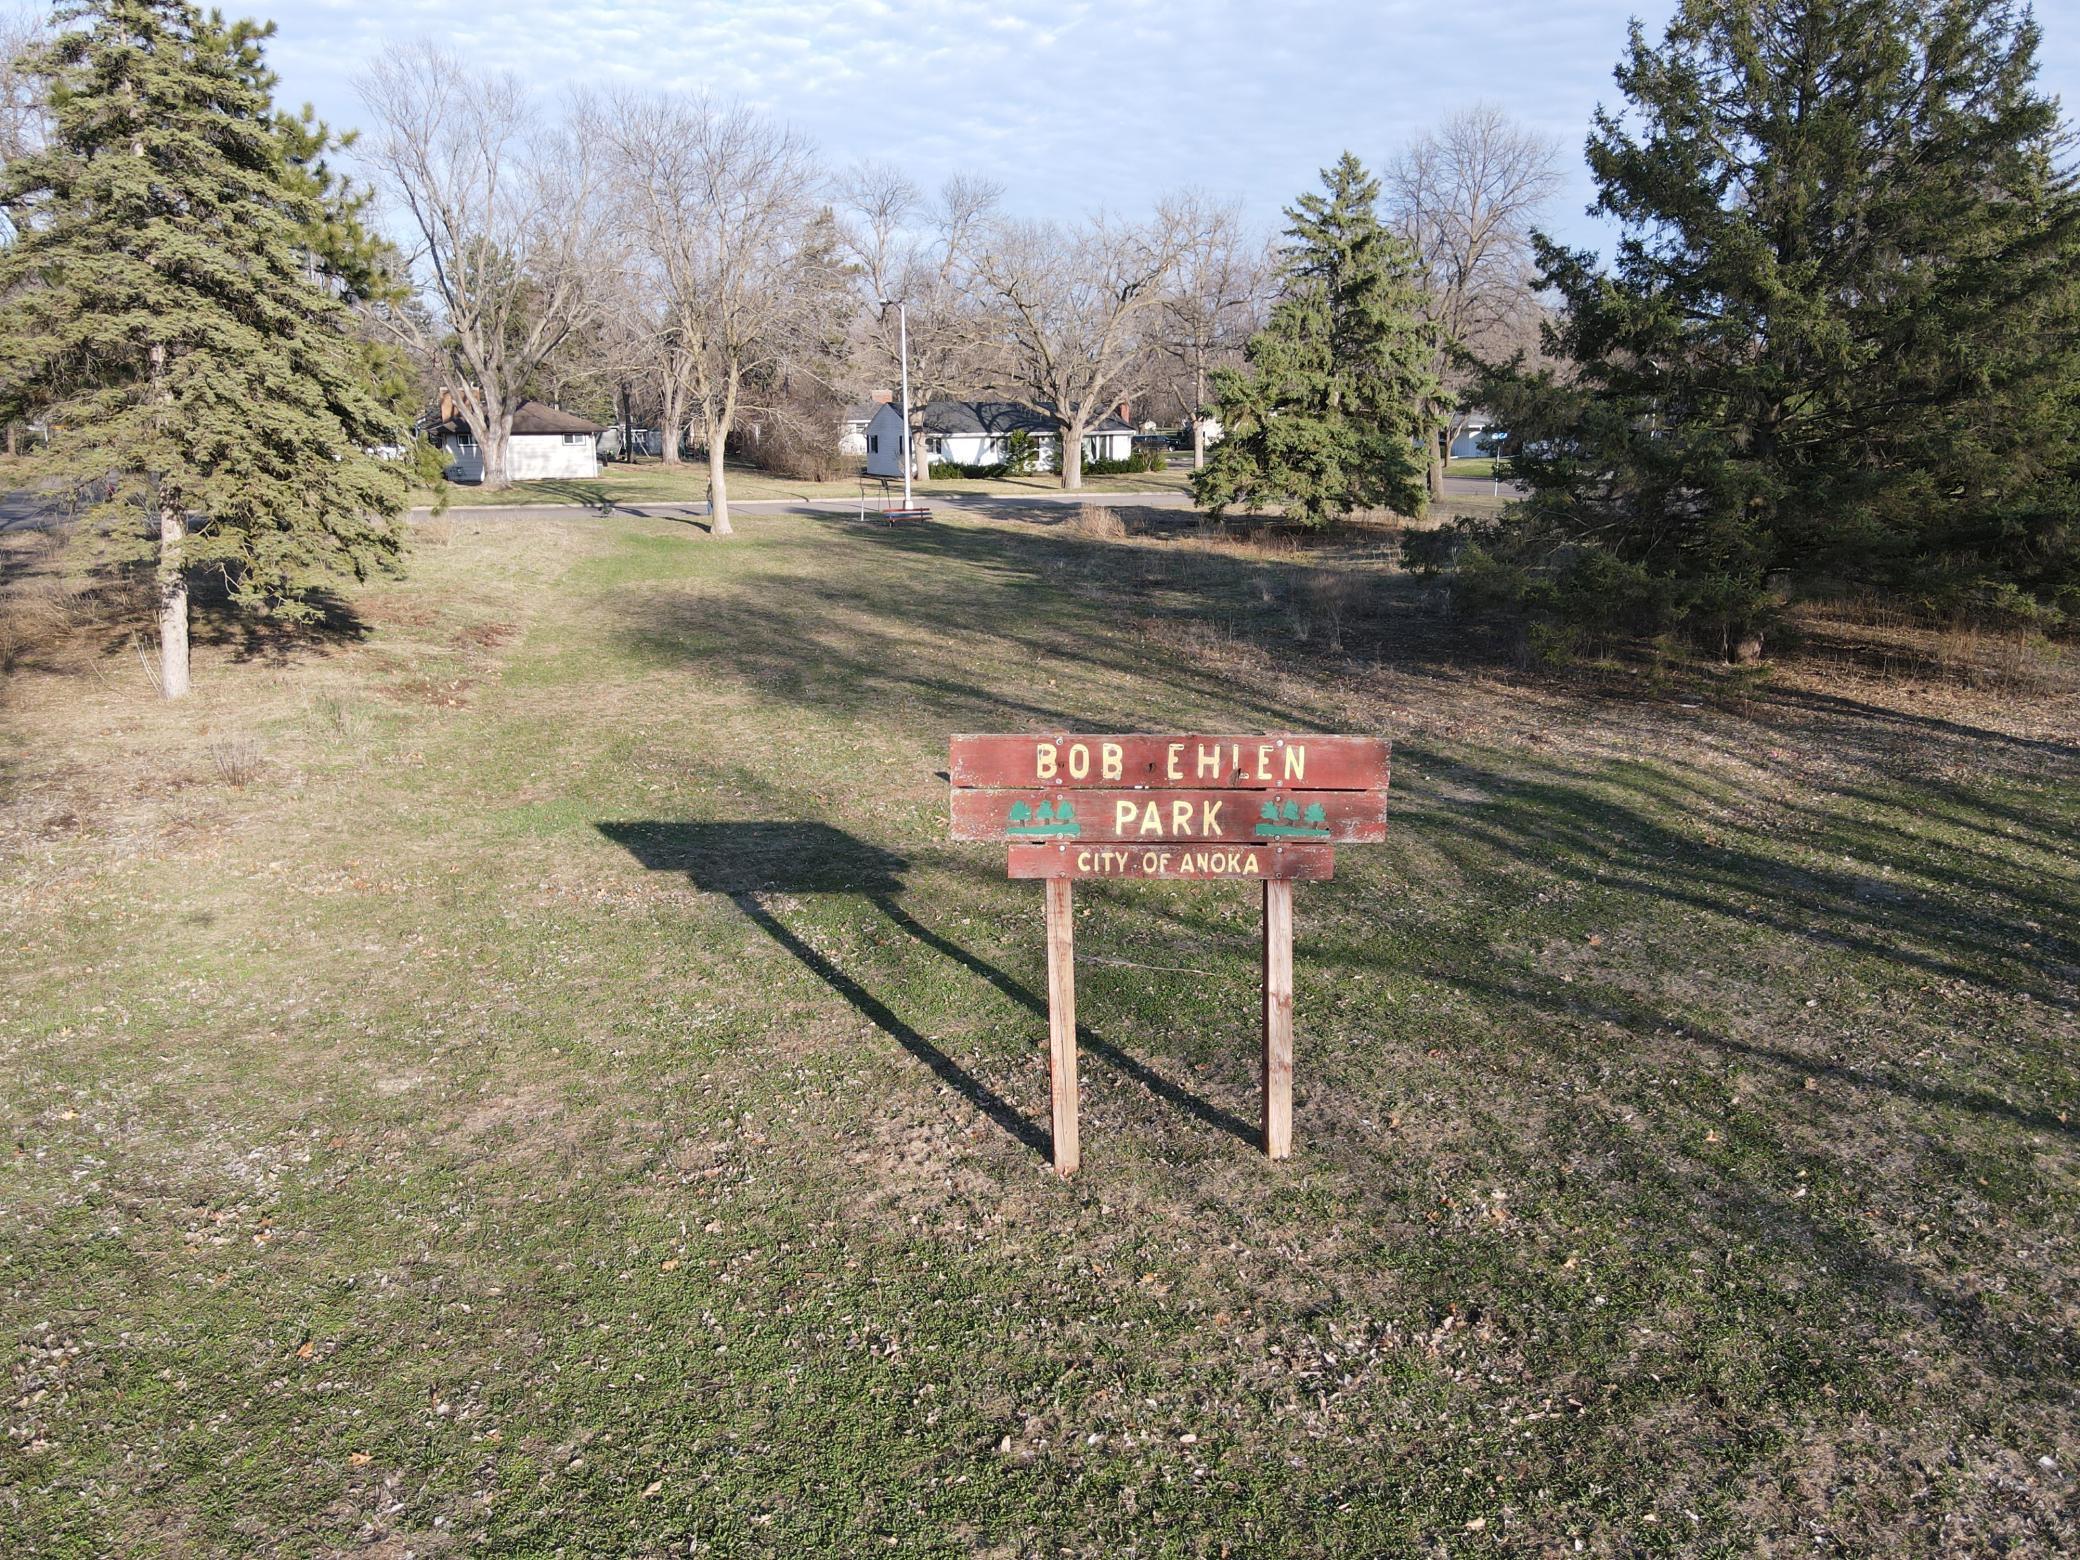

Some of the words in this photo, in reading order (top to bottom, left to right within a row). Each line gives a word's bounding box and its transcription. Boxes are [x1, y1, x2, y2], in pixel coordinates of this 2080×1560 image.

[1036, 743, 1123, 780] BOB
[1167, 743, 1306, 781] EHLEN
[1115, 800, 1223, 837] PARK
[1078, 851, 1129, 873] CITY
[1142, 851, 1172, 873] OF
[1180, 852, 1260, 875] ANOKA
